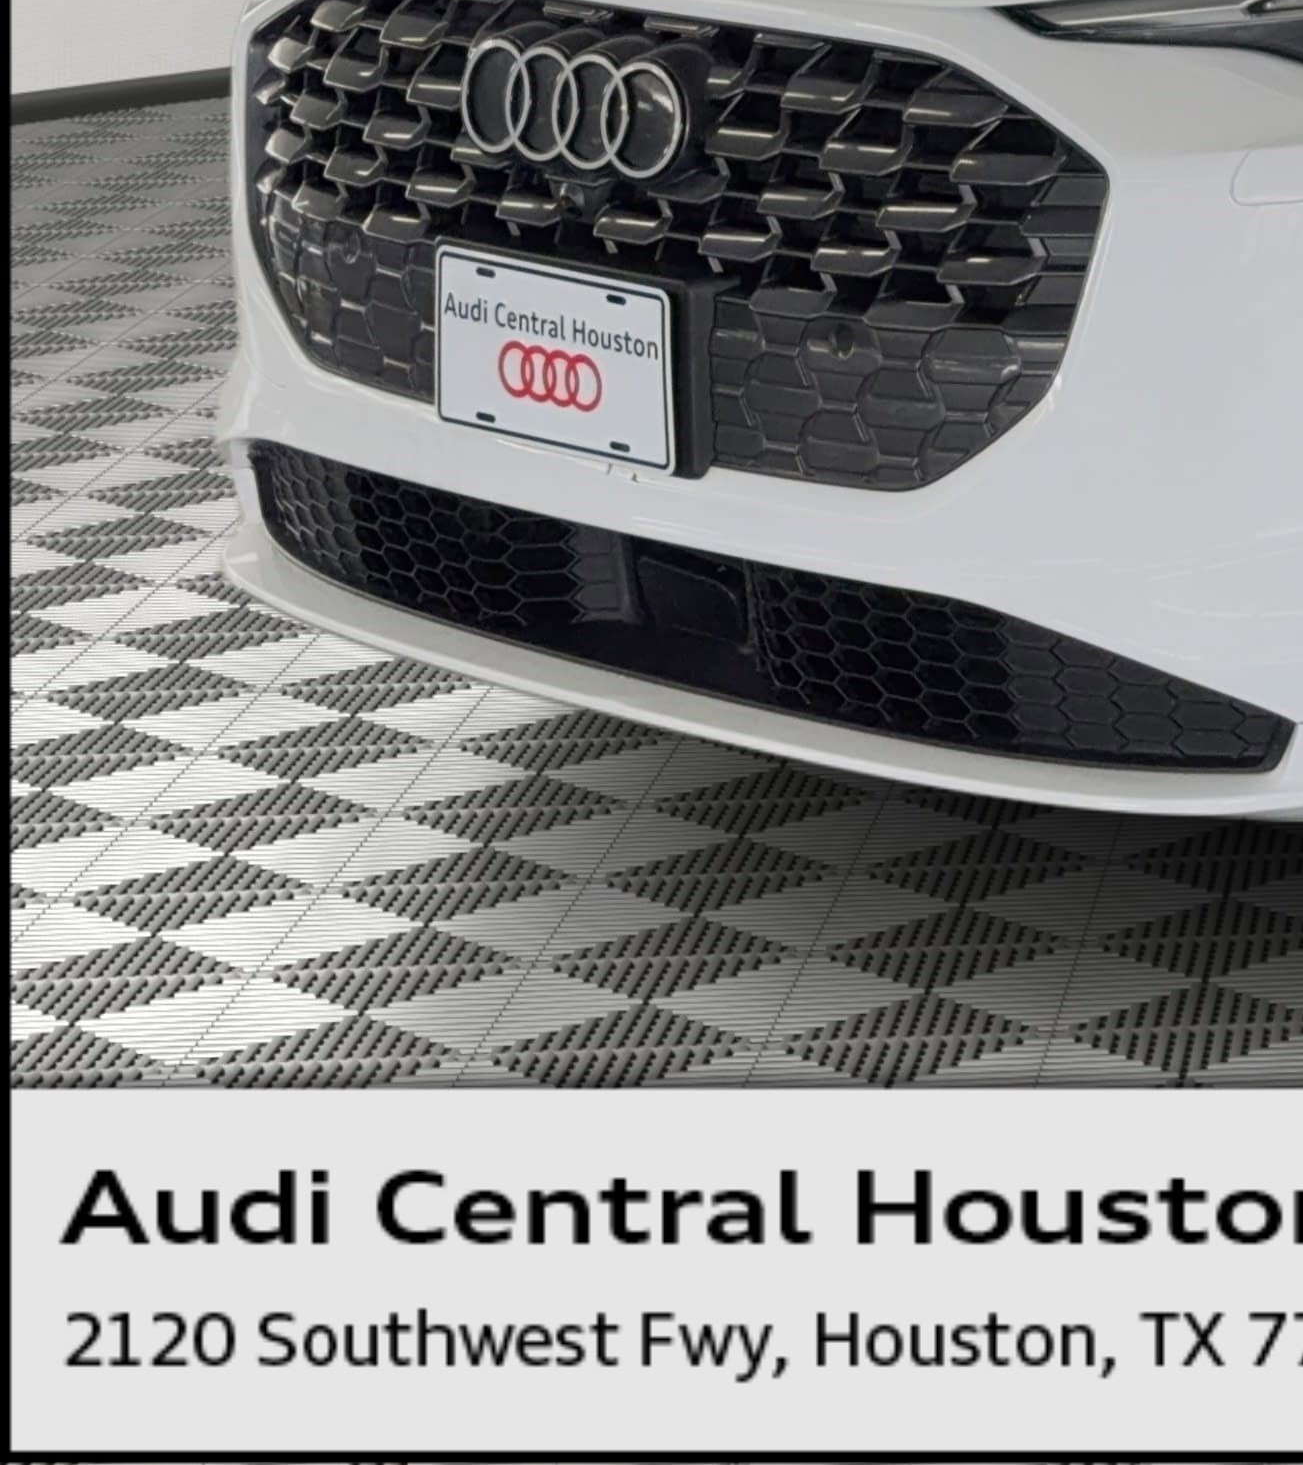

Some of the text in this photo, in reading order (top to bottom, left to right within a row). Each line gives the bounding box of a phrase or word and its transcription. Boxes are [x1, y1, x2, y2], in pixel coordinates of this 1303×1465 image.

[444, 291, 659, 360] Audi Central Houston
